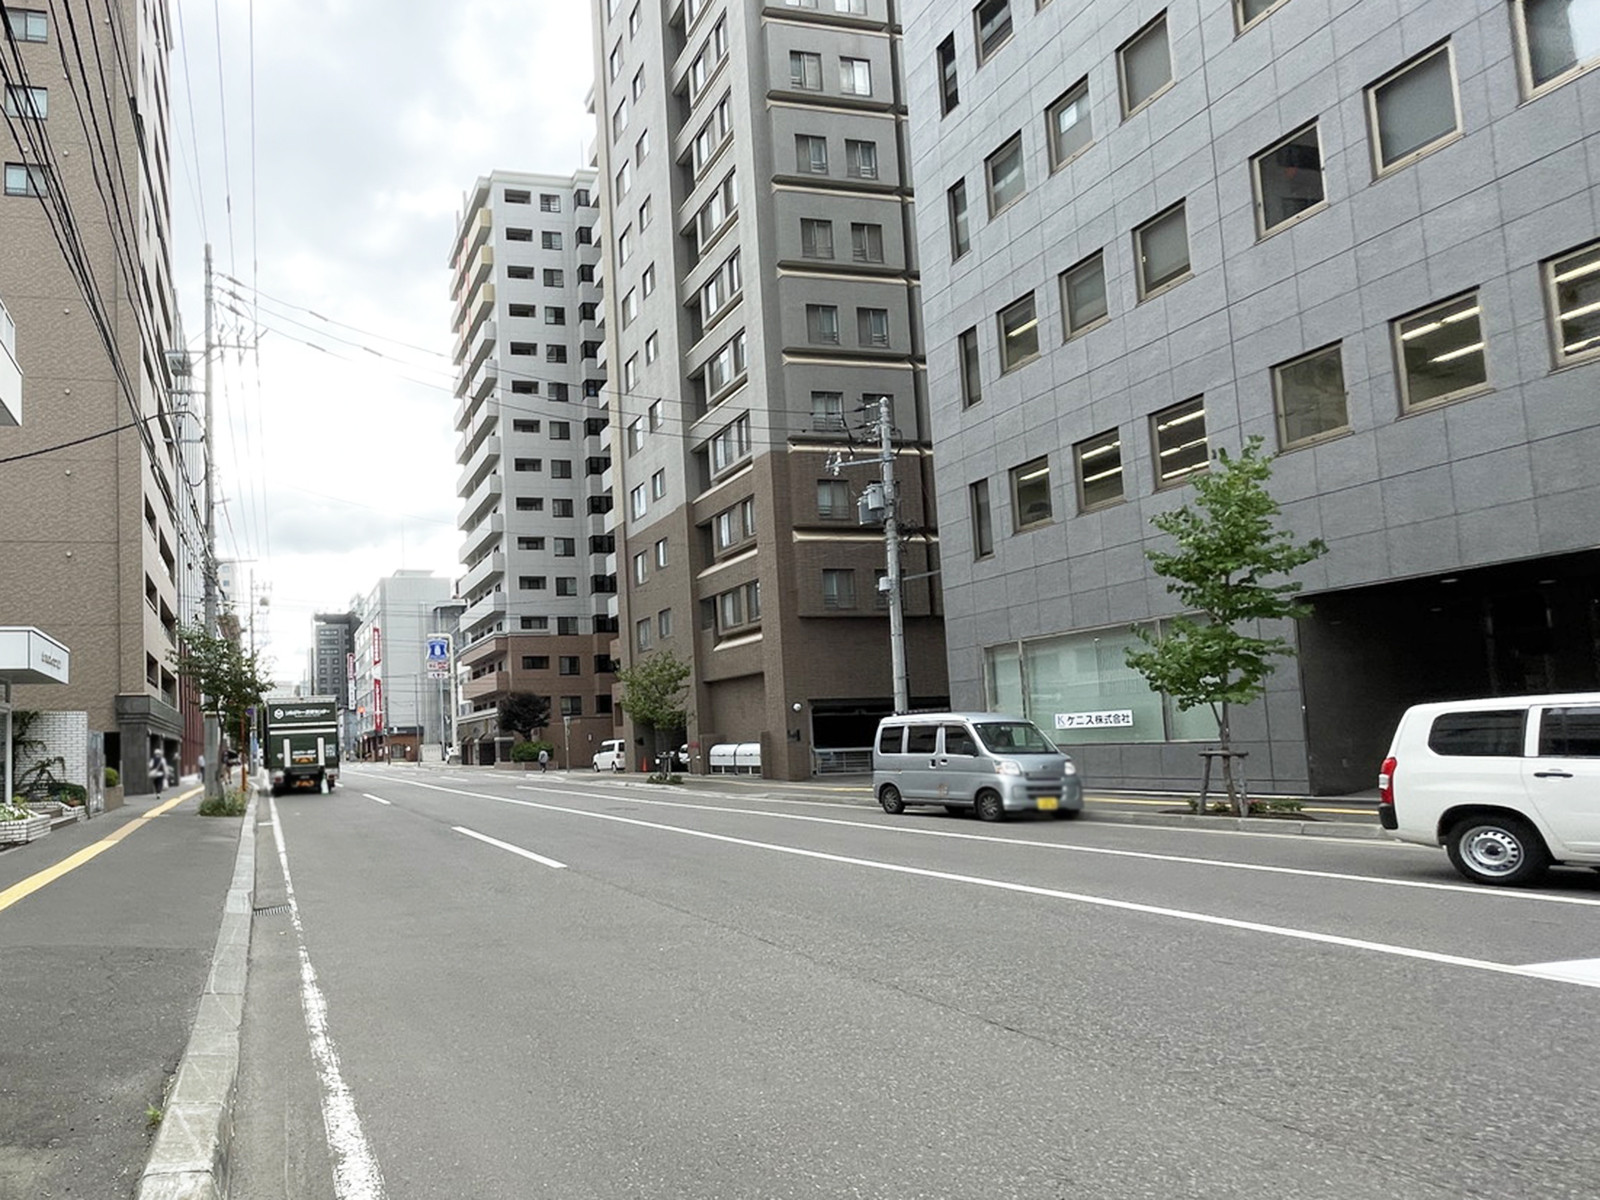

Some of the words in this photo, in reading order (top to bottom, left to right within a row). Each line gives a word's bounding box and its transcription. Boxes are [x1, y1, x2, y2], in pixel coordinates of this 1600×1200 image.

[1067, 713, 1130, 726] ケニス株式会社
